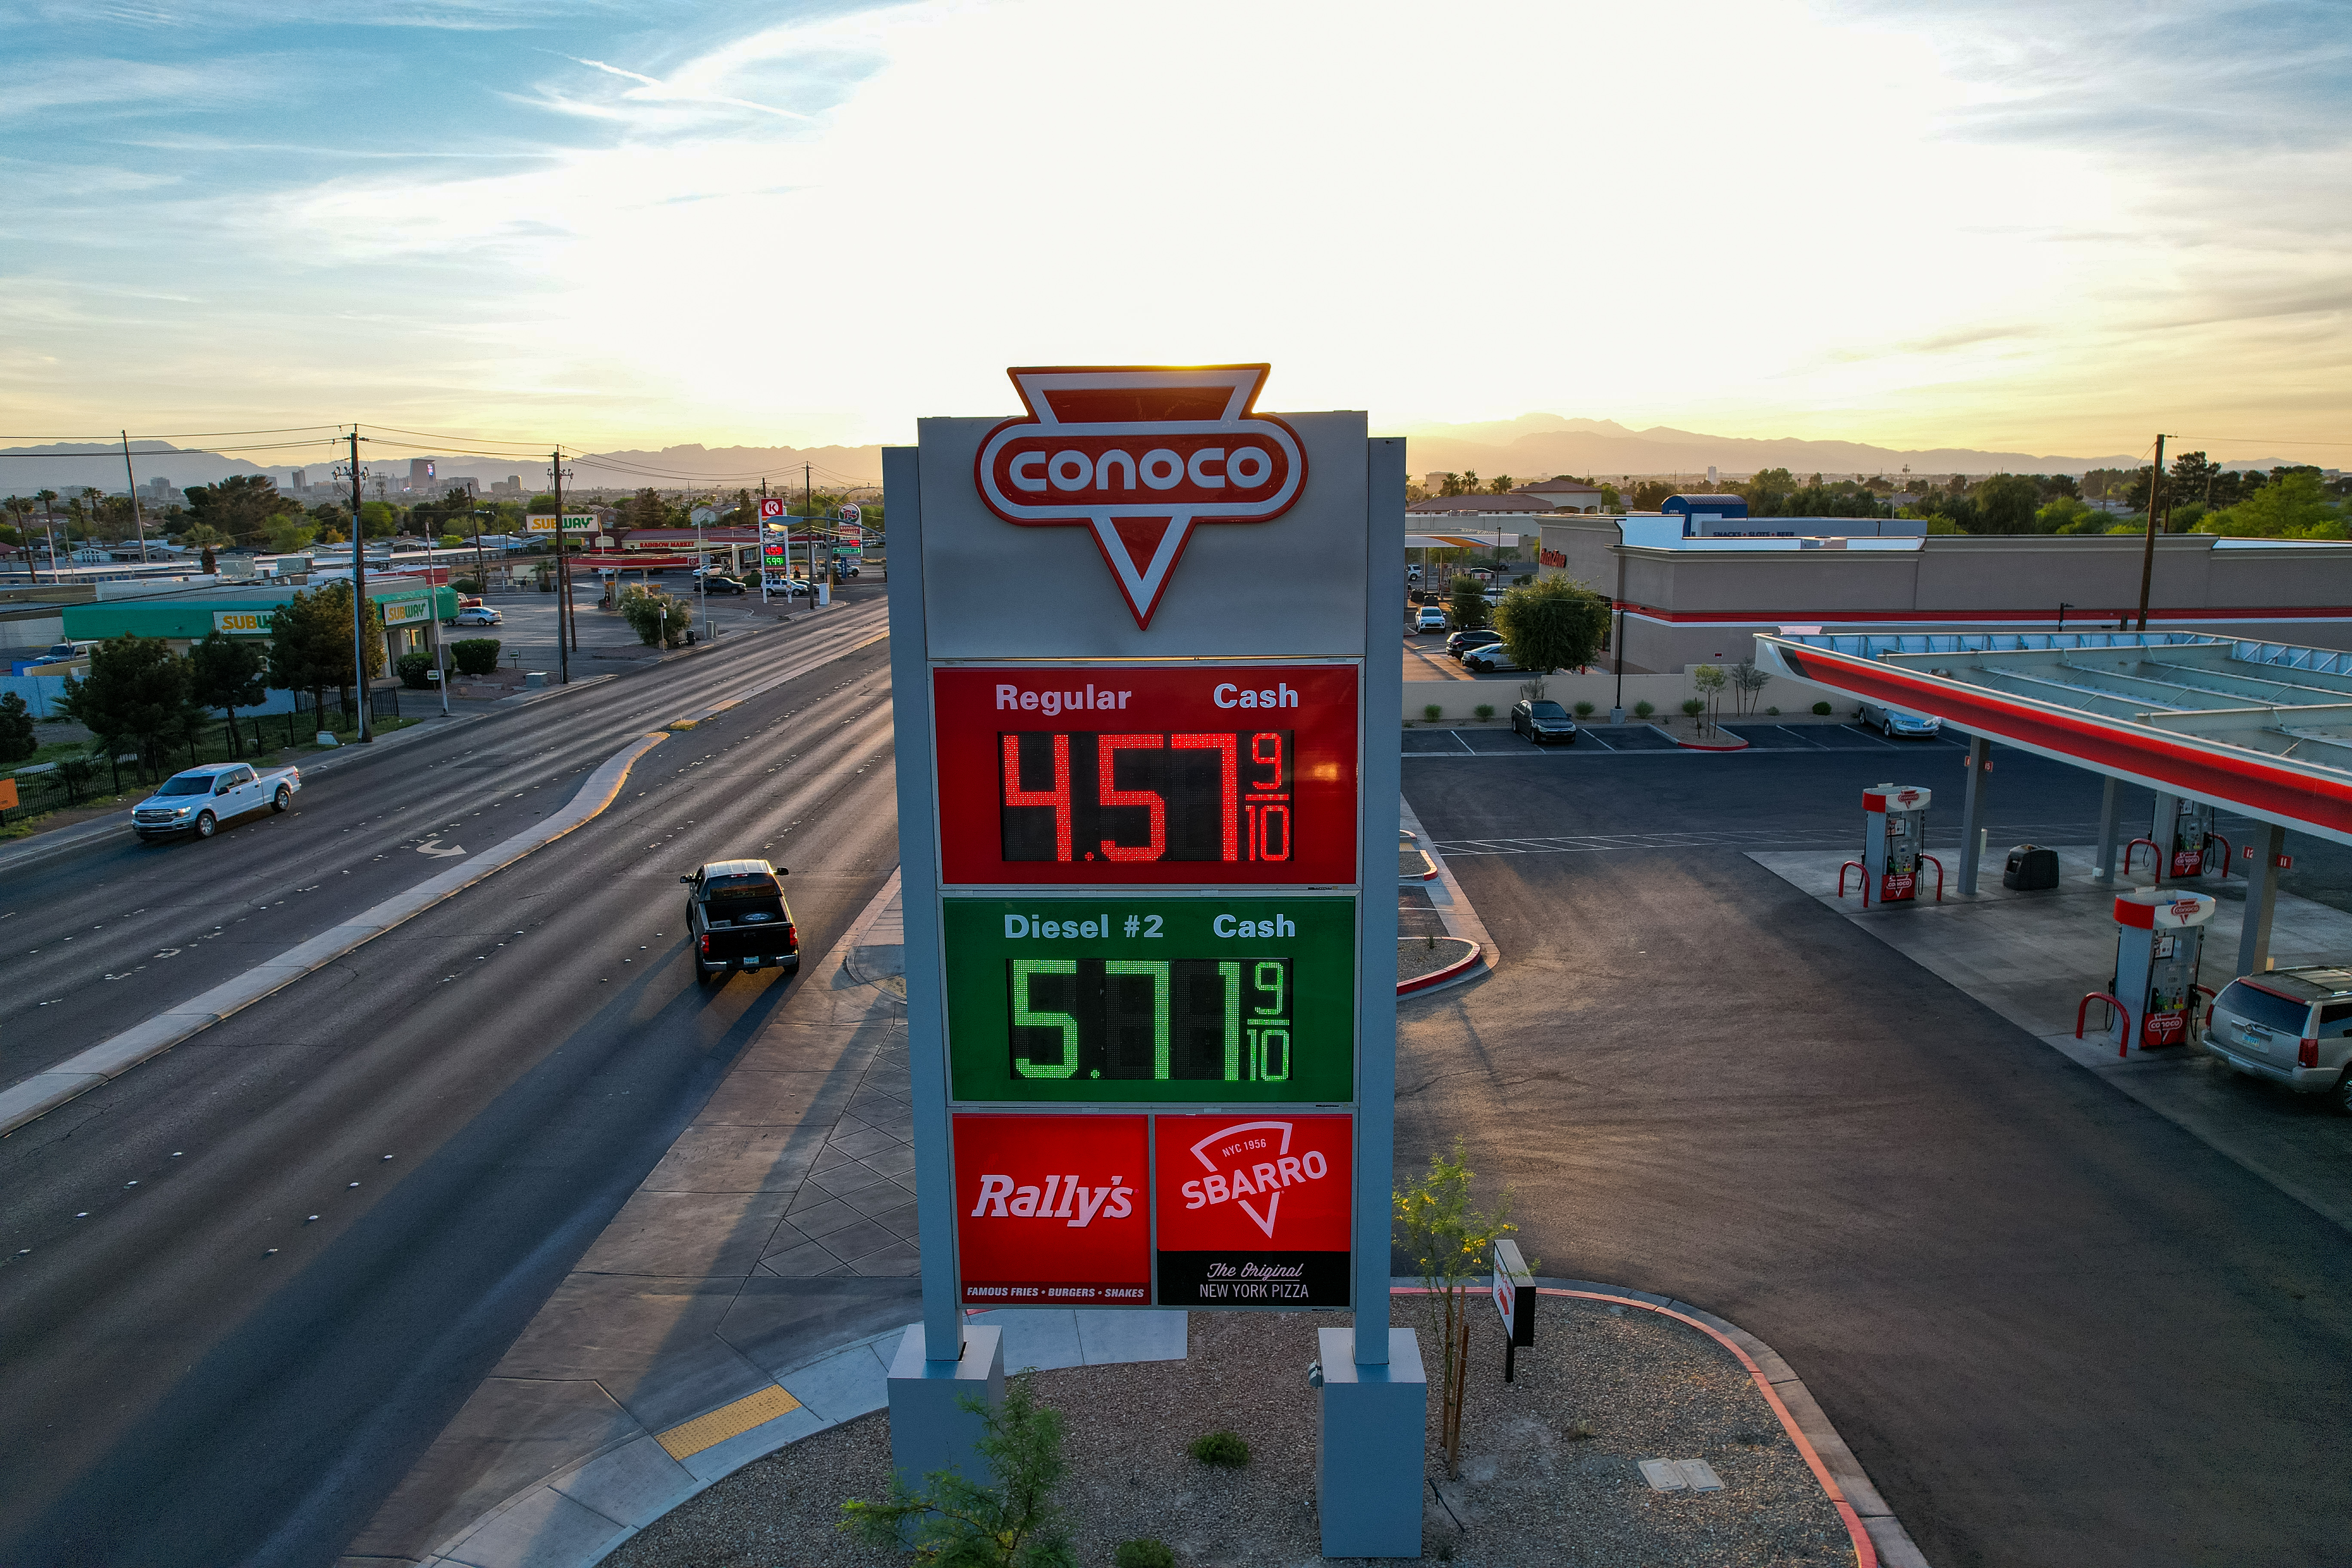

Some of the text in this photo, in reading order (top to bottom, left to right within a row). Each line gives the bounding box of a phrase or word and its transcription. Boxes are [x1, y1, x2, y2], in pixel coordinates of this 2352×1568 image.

[1009, 446, 1272, 492] conoco
[769, 504, 778, 514] K
[388, 603, 426, 622] SUBWAY
[221, 615, 274, 631] SUBW
[995, 683, 1298, 716] Regular Cash
[1985, 762, 1991, 770] 15
[1003, 733, 1237, 861] 4.57
[2280, 857, 2287, 867] 11
[1004, 914, 1295, 938] Diesel #2 Cash
[1013, 959, 1240, 1081] 5.71
[1222, 1138, 1267, 1158] NYC 1956
[1181, 1150, 1328, 1210] SBARRO
[971, 1174, 1133, 1227] Rally's
[1207, 1262, 1302, 1281] The Original
[967, 1286, 1144, 1298] FAMOUS FRIES BURGERS SHAKES
[1200, 1283, 1309, 1298] NEW YORK PIZZA
